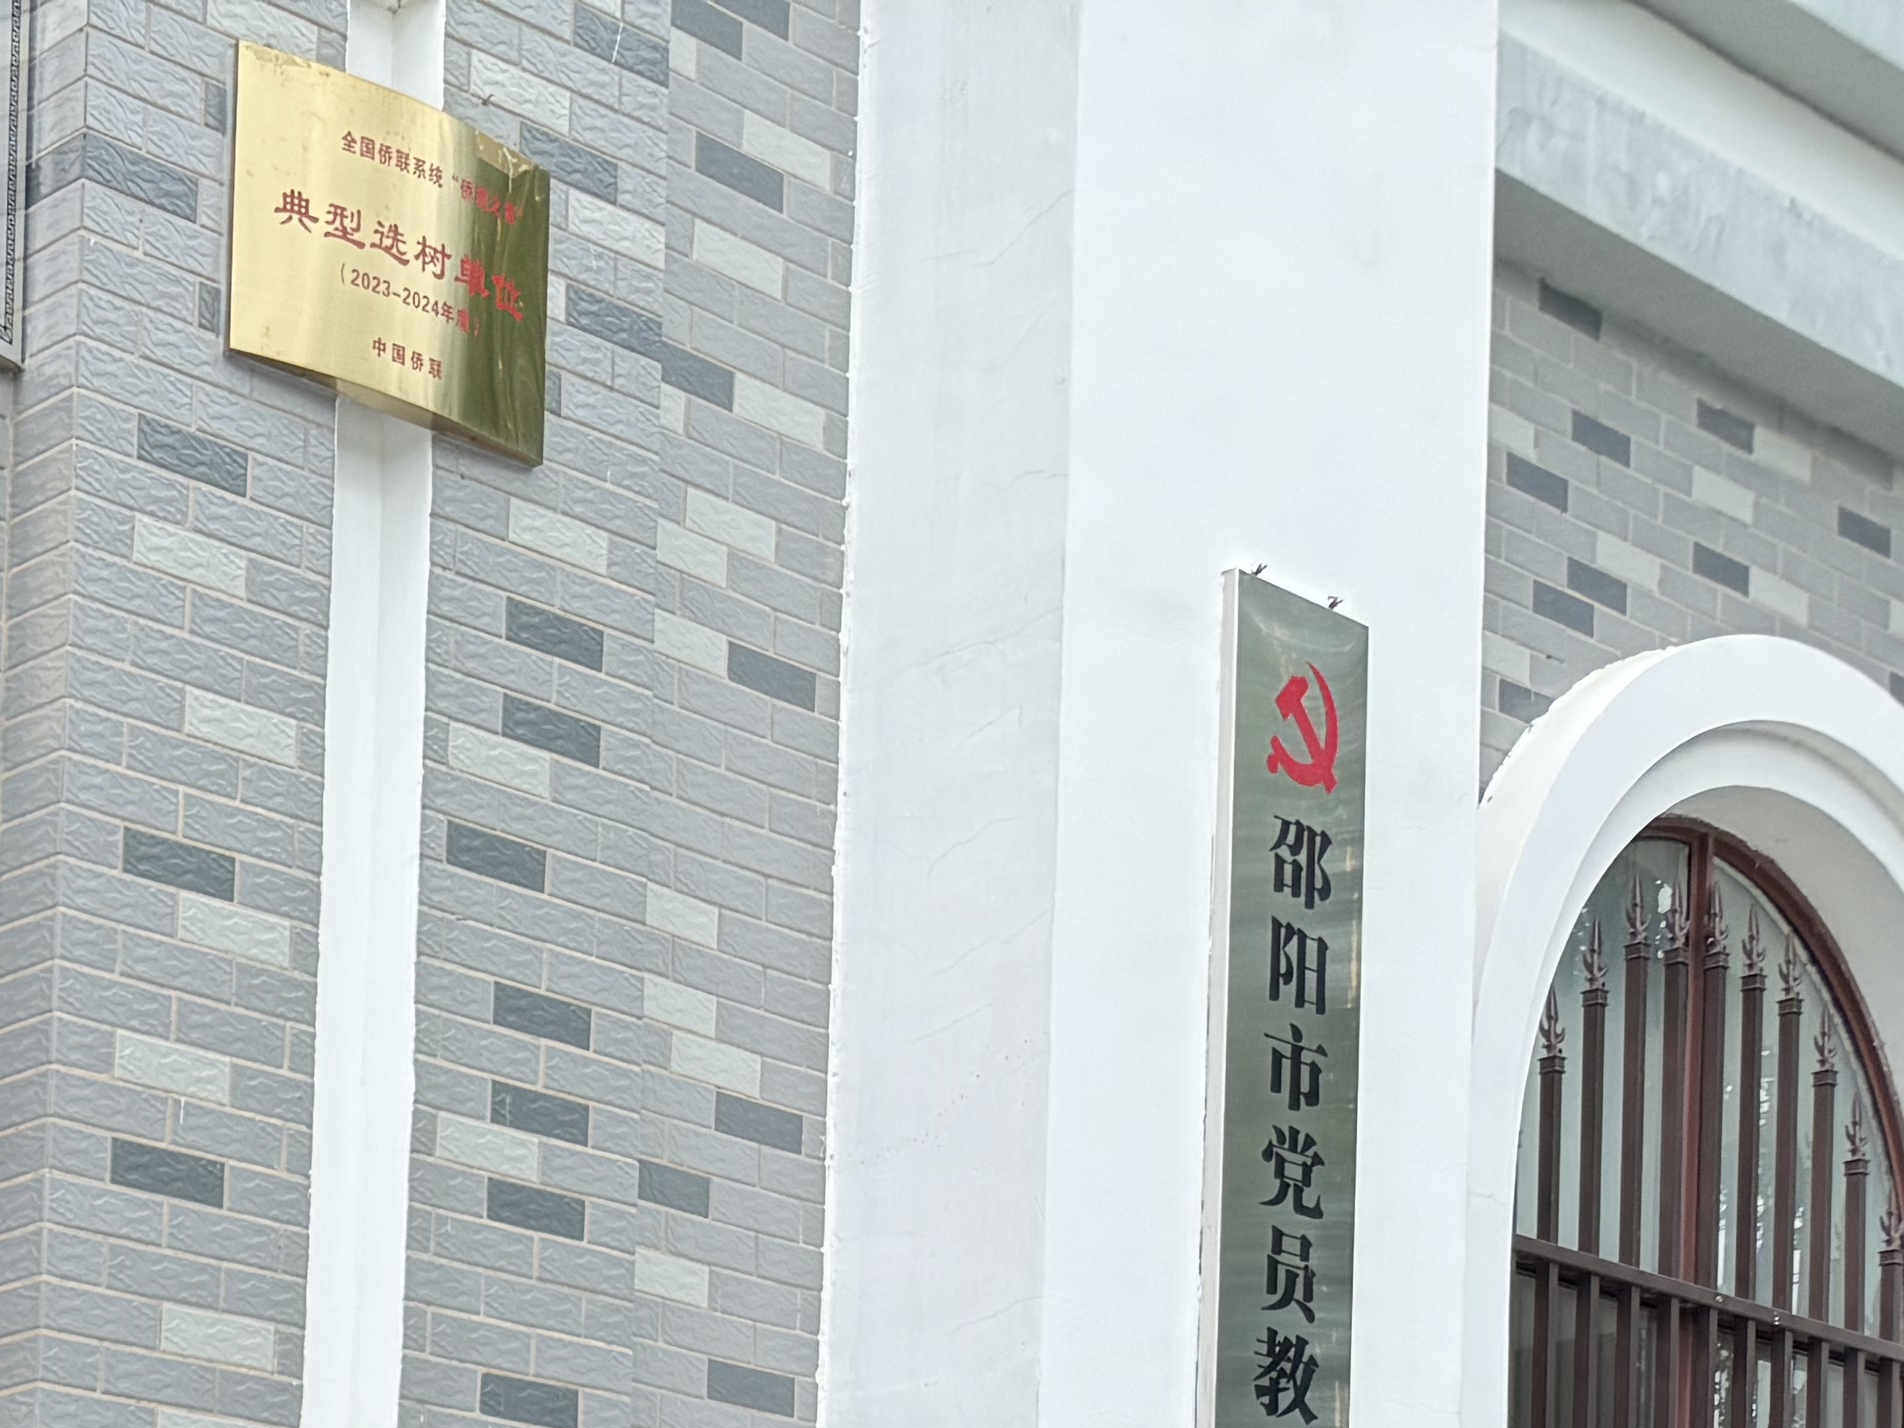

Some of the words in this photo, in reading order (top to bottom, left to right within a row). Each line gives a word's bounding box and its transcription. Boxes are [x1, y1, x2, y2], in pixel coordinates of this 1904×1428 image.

[274, 189, 523, 321] 典型选树单位
[372, 337, 443, 380] 中国侨联
